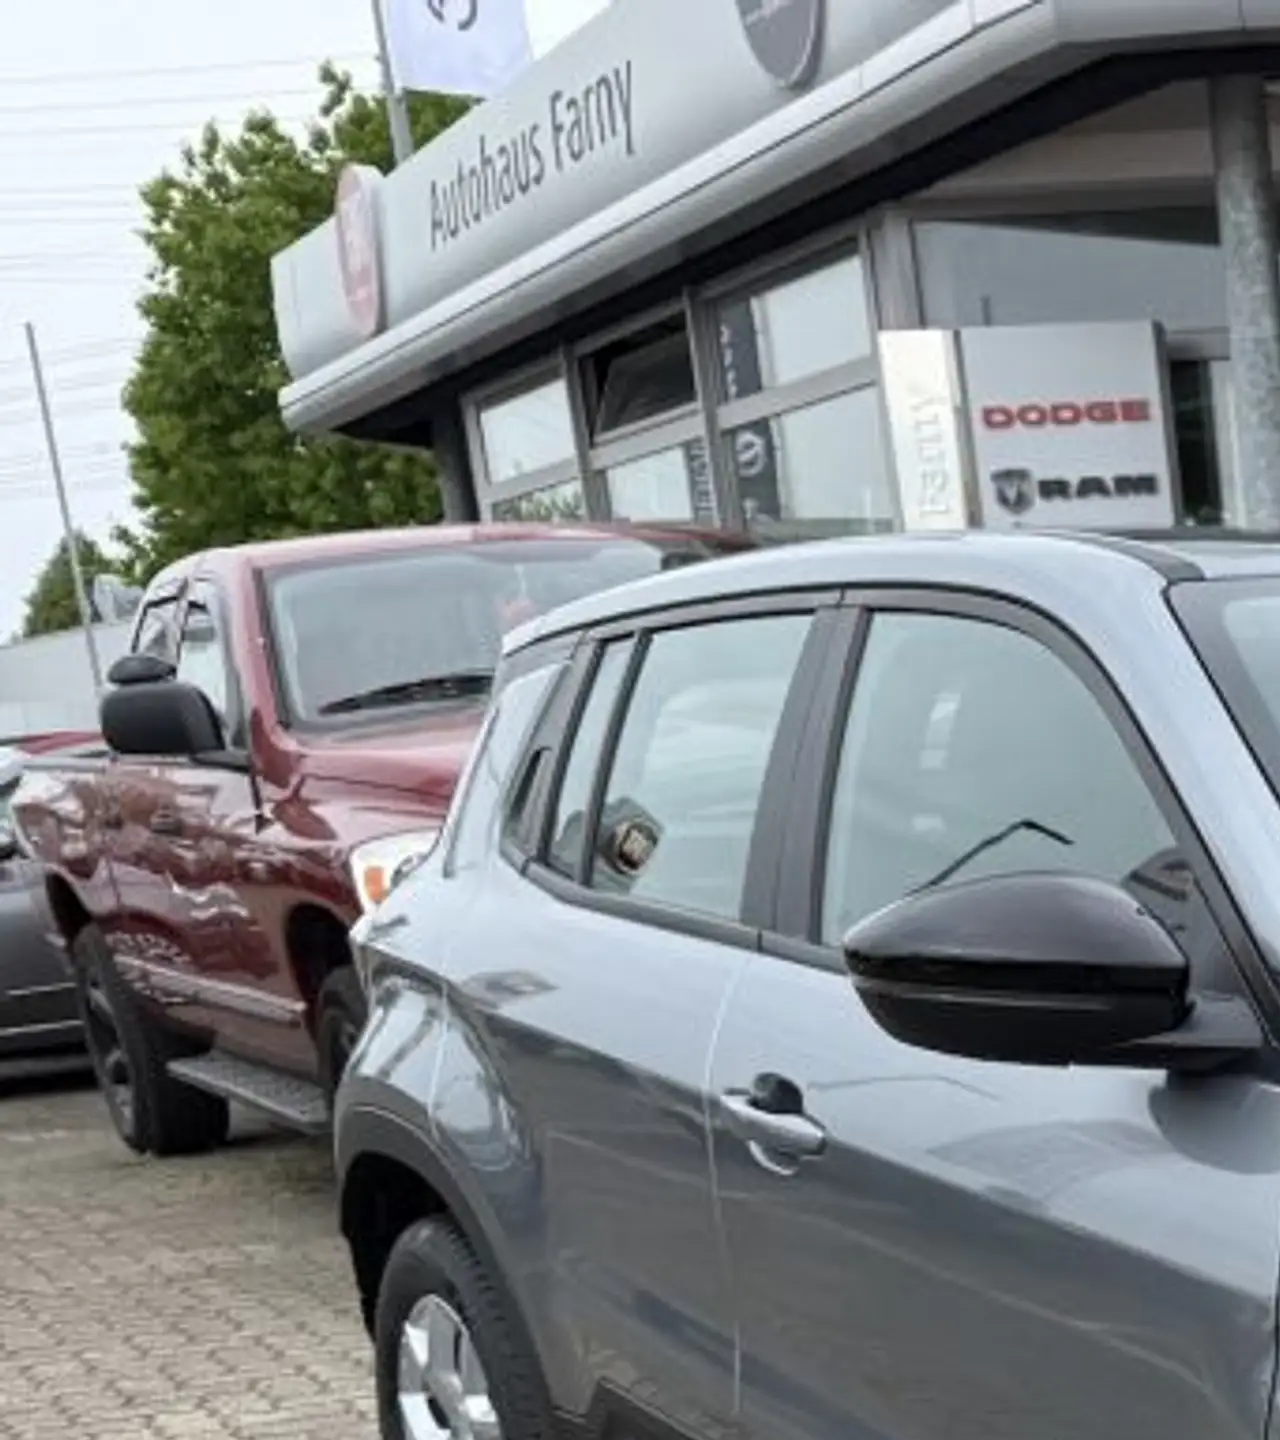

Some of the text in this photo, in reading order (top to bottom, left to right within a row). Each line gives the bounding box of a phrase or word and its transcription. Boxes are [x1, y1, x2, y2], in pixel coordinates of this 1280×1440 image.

[430, 59, 634, 252] Autohaus Farny
[981, 397, 1151, 429] DODGE
[1038, 473, 1159, 501] RAM
